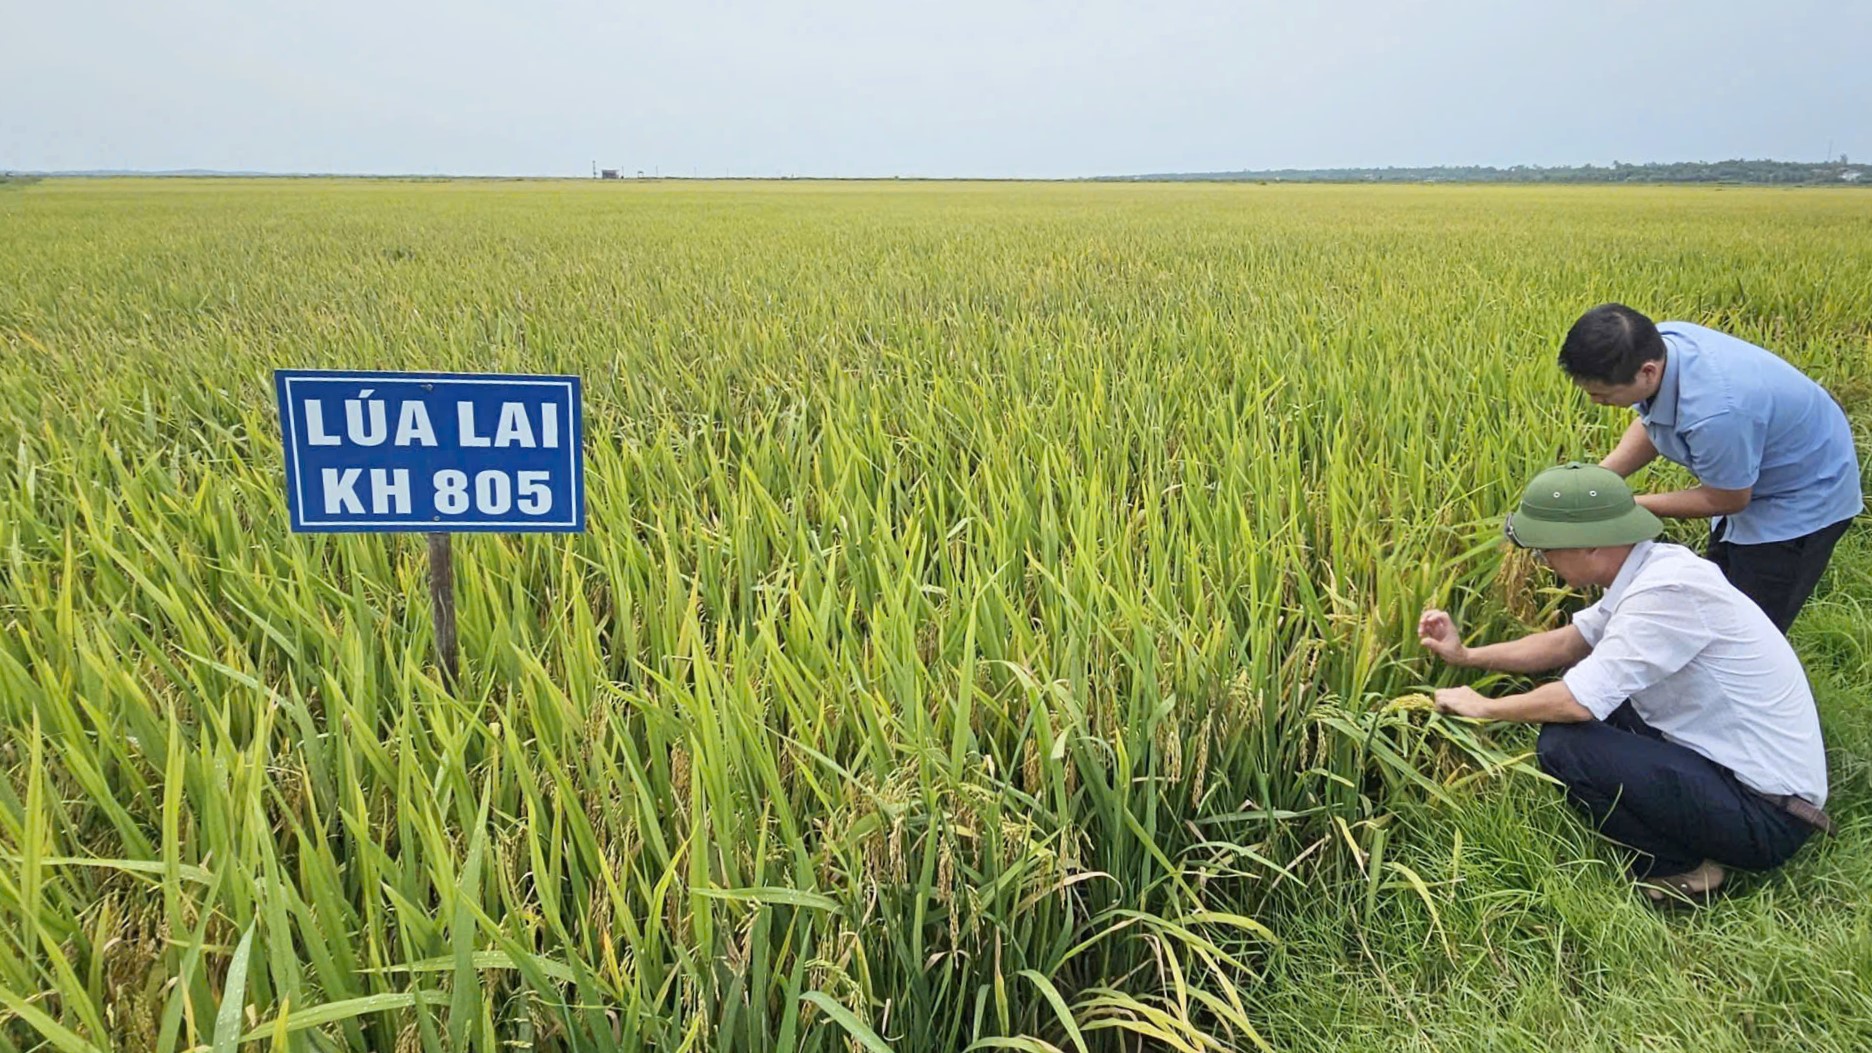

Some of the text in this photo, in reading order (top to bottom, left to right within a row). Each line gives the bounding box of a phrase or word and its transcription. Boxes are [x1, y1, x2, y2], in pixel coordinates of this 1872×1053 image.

[304, 389, 559, 448] LÚA LAI
[321, 468, 553, 516] KH 805
